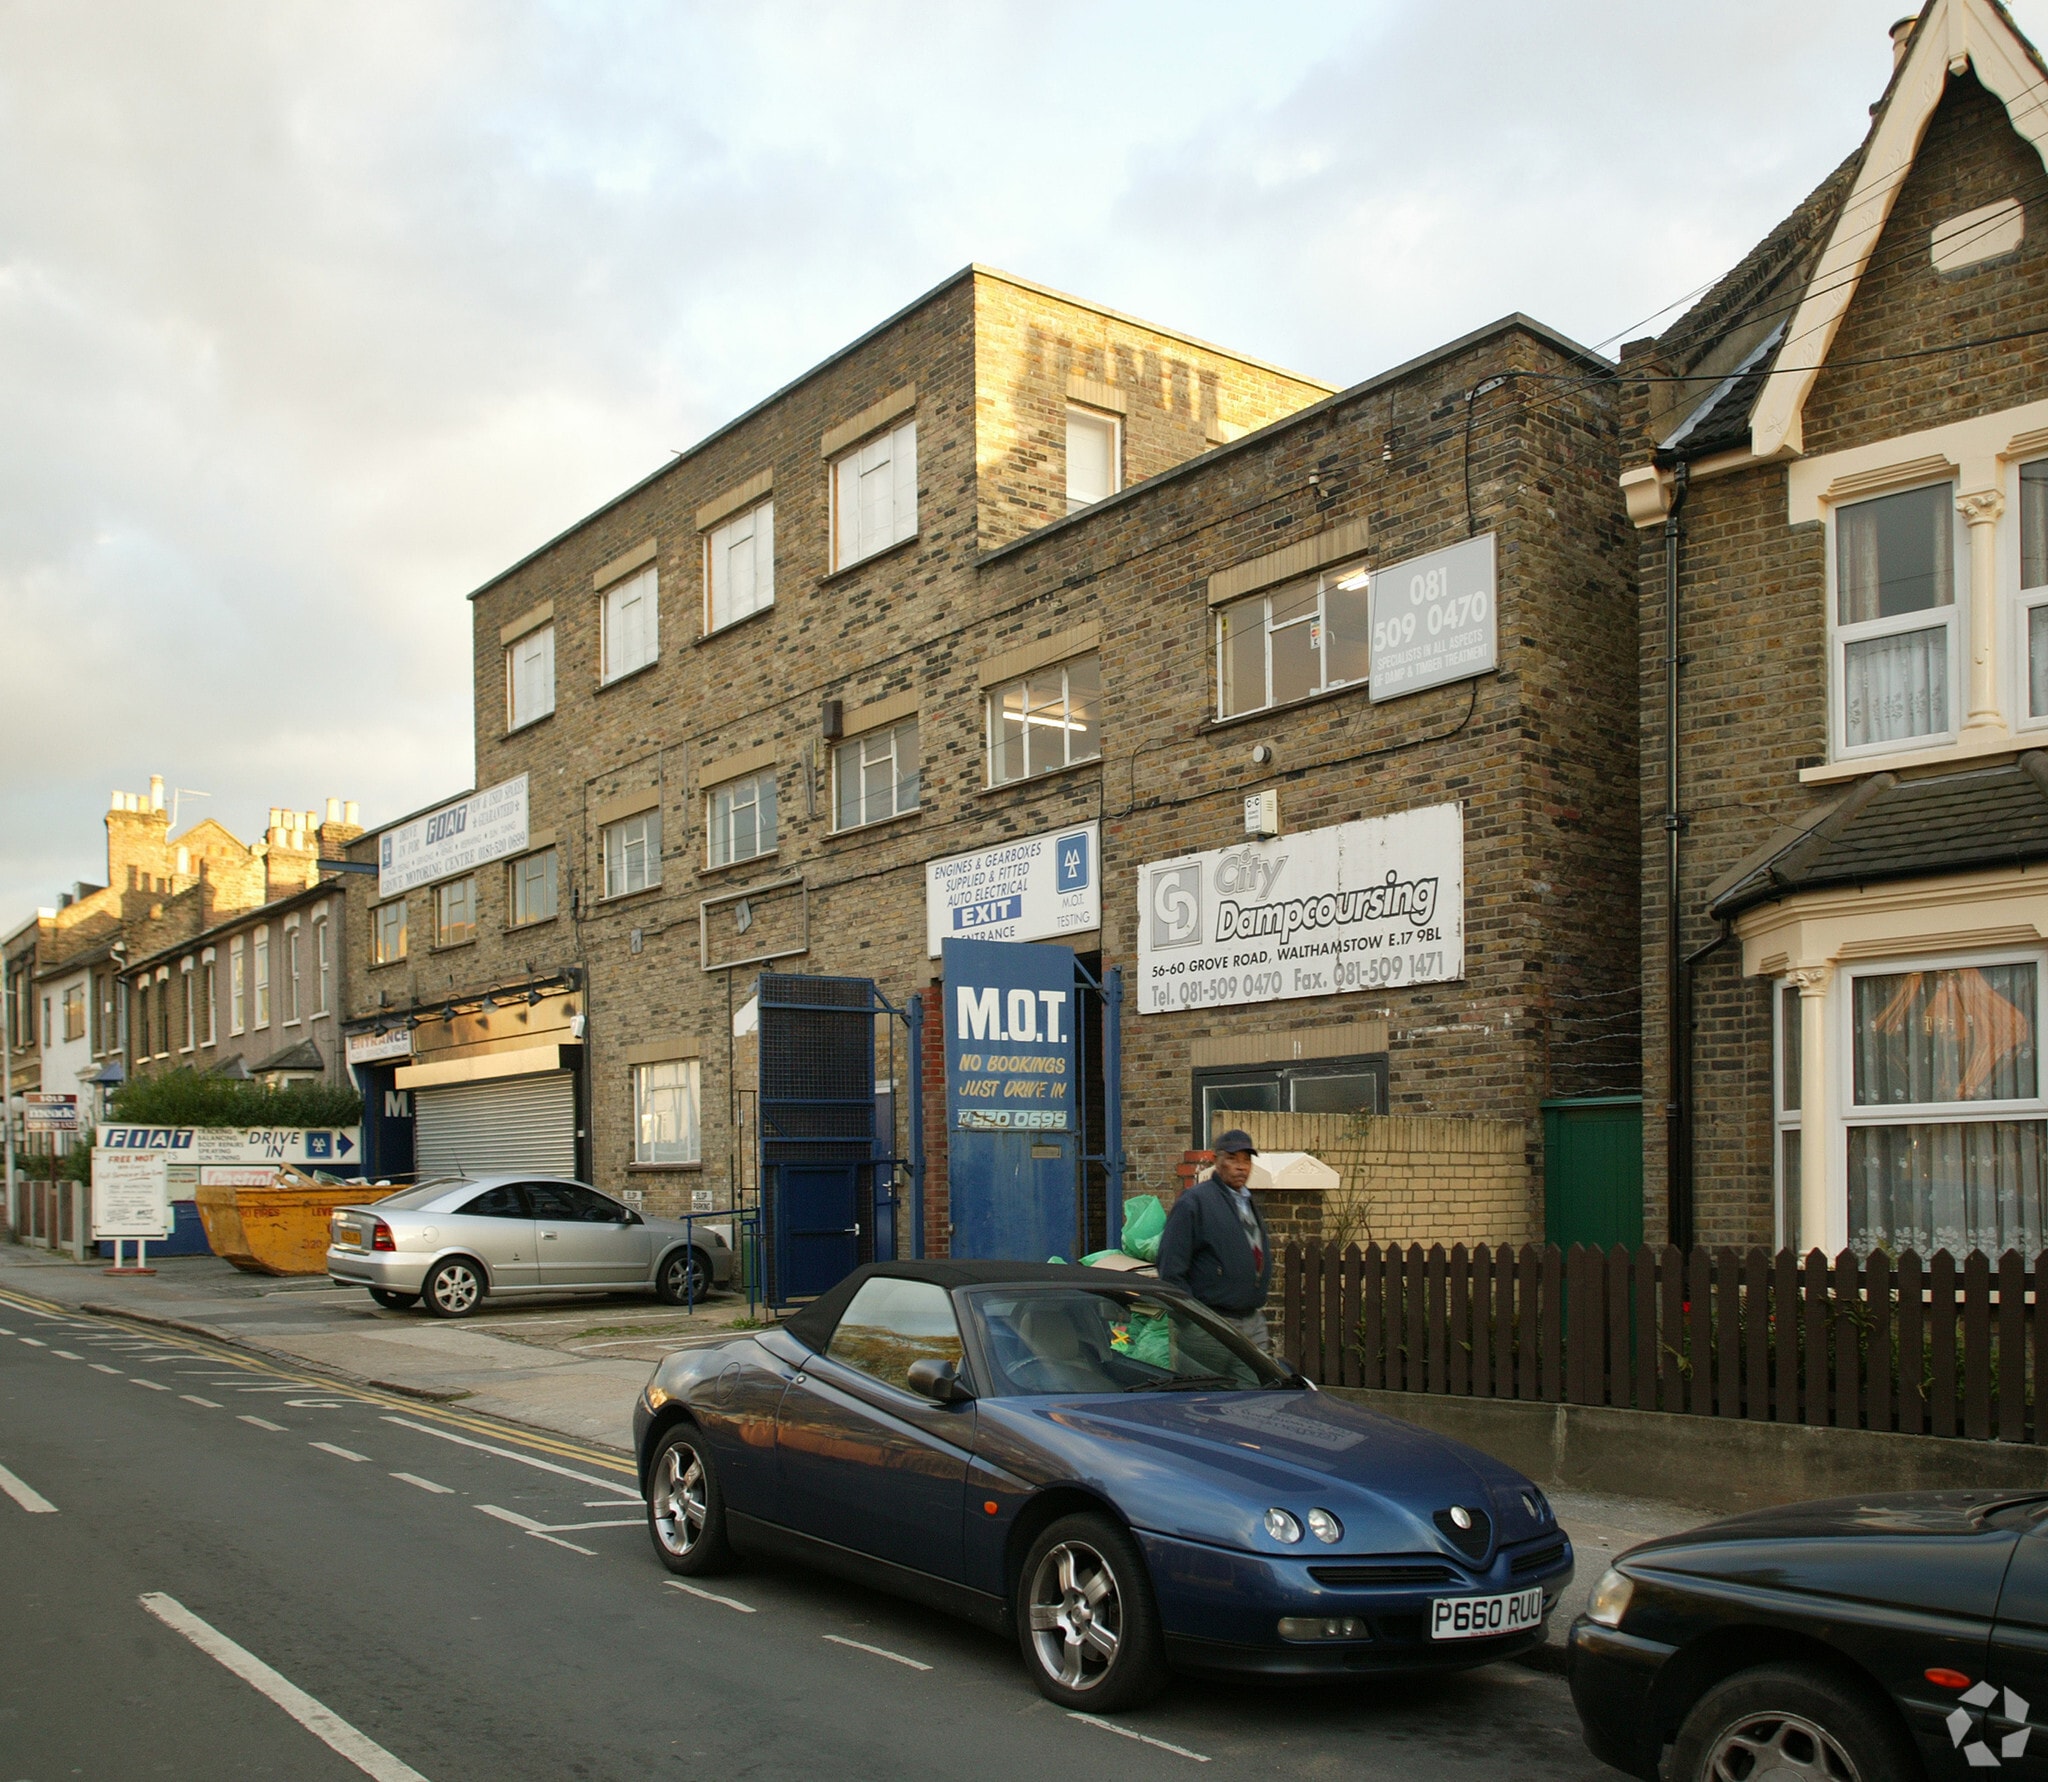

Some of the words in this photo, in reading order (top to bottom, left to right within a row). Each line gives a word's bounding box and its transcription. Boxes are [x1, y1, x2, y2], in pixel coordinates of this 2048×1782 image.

[1410, 566, 1447, 605] 081
[1374, 612, 1416, 652] 509
[1427, 590, 1488, 636] 0470
[1377, 646, 1423, 671] SPECIALISTS
[1423, 643, 1431, 656] IN
[1433, 639, 1447, 655] ALL
[1449, 628, 1484, 649] ASPECTS
[1374, 675, 1384, 688] OF
[1385, 669, 1406, 685] DAMP
[1407, 665, 1414, 678] &
[1416, 657, 1443, 676] TIMBER
[1444, 643, 1489, 667] TREATMENT
[398, 824, 418, 843] DRIVE
[427, 805, 468, 845] FIAT
[382, 874, 403, 895] GROVE
[405, 861, 442, 886] MOTORING
[445, 849, 475, 872] CENTRE
[935, 861, 972, 880] ENGINES
[975, 857, 981, 870] &
[985, 842, 1042, 868] GEARBOXES
[946, 872, 986, 893] SUPPLIED
[988, 869, 995, 882] &
[998, 861, 1030, 881] FITTED
[1213, 850, 1289, 902] City
[947, 889, 972, 908] AUTO
[975, 878, 1028, 902] ELECTRICAL
[1062, 893, 1084, 908] M.O.T.
[1215, 869, 1439, 945] Dampcoursing
[962, 899, 1012, 927] EXIT
[1056, 911, 1091, 928] TESTING
[1152, 962, 1186, 978] 56-60
[1189, 956, 1229, 972] GROVE
[1233, 951, 1272, 968] ROAD,
[1277, 935, 1383, 961] WALTHAMSTOW
[1388, 931, 1414, 947] E.17
[1416, 926, 1442, 943] 9BL
[1152, 982, 1175, 1007] Tel.
[1179, 975, 1238, 1004] 081-509
[1243, 970, 1283, 997] 0470
[1294, 968, 1328, 992] Fax.
[1333, 955, 1403, 987] 081-509
[1409, 951, 1444, 978] 1471
[956, 986, 1068, 1043] M.O.T.
[351, 1030, 408, 1050] ENTRANCE
[959, 1053, 982, 1072] NO
[986, 1055, 1066, 1075] BOOKINGS
[959, 1080, 1001, 1098] JUST
[1003, 1080, 1049, 1098] DRIVE
[1050, 1082, 1068, 1099] IN
[972, 1111, 1011, 1127] 520
[1013, 1111, 1068, 1128] 0699
[109, 1129, 192, 1148] FIAT
[249, 1131, 301, 1145] DRIVE
[265, 1145, 285, 1159] IN
[108, 1155, 131, 1164] FREE
[135, 1154, 155, 1162] MOT
[210, 1171, 273, 1186] Castrol
[254, 1208, 280, 1217] FIRES
[693, 1202, 711, 1211] PARKING
[1435, 1600, 1502, 1632] P660
[1508, 1590, 1542, 1625] RUU
